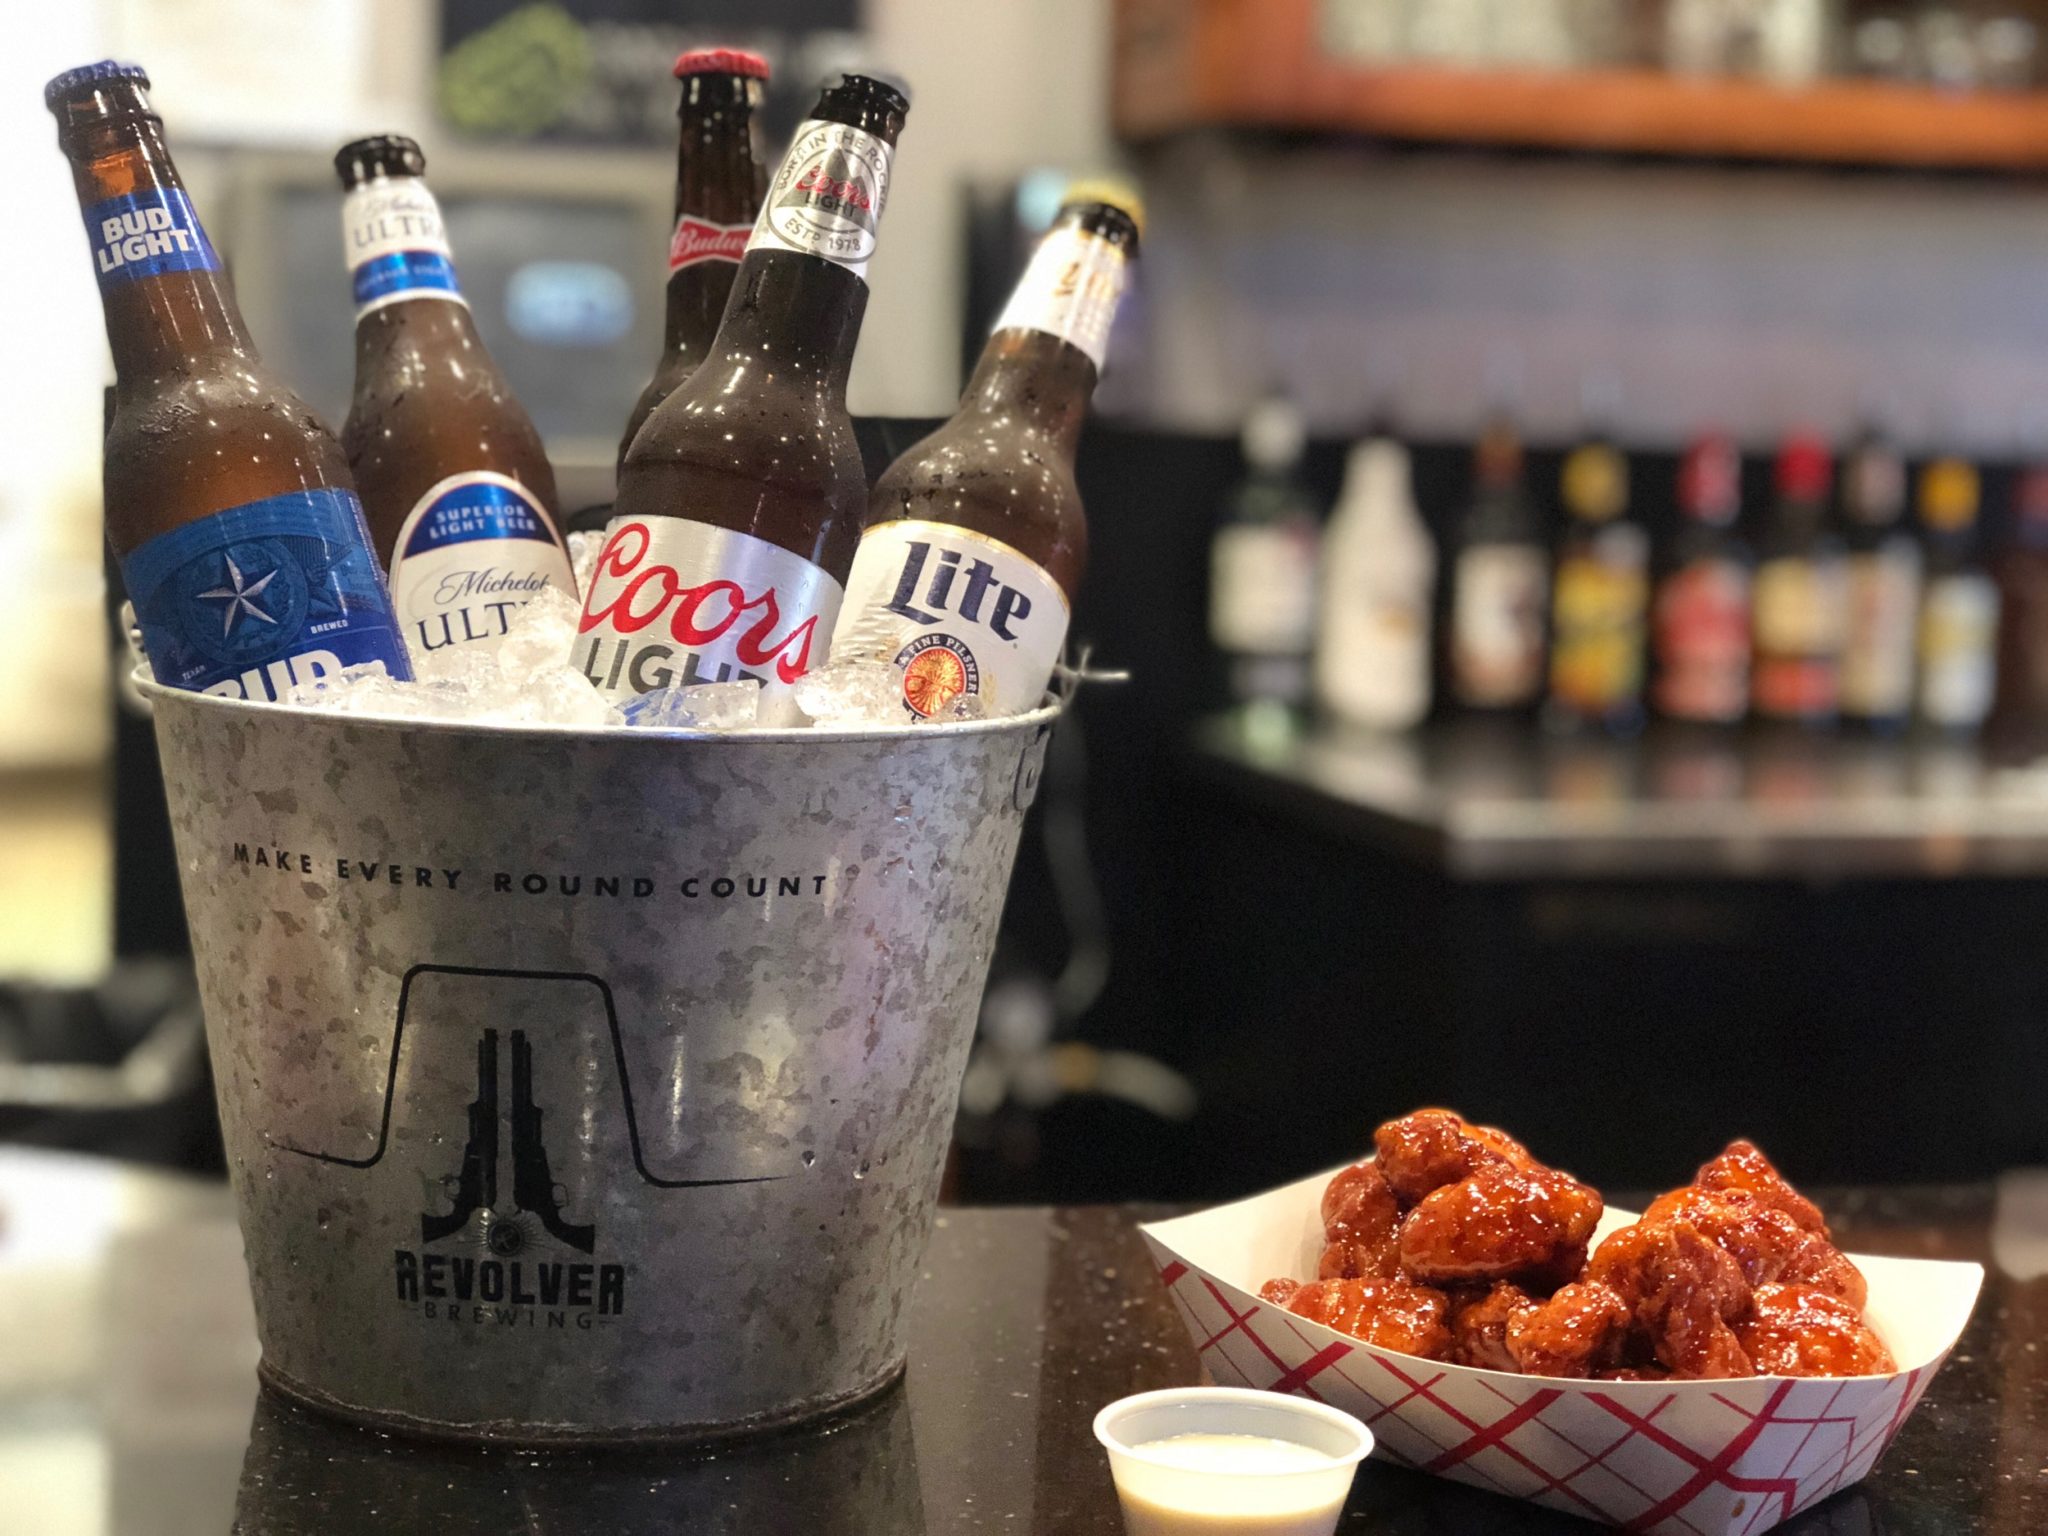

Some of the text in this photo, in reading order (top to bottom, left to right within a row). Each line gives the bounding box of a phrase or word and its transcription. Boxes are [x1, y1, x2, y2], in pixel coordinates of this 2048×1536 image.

[808, 133, 828, 150] IN
[795, 160, 871, 214] Coors
[804, 190, 857, 218] LIGHT
[101, 207, 172, 245] BUD
[828, 237, 862, 252] 1978
[98, 229, 191, 274] LIGHT
[429, 518, 536, 540] LIGHT BEER
[436, 504, 526, 524] SUPERIOR
[578, 522, 818, 685] Coors
[882, 541, 1032, 641] Lite
[310, 619, 349, 634] BREWED
[416, 600, 530, 652] ULT
[908, 634, 942, 656] FINE
[945, 634, 979, 694] PILSNER
[233, 842, 827, 898] MAKE EVERY ROUND COUNT
[394, 1249, 625, 1316] REVOLVER
[423, 1301, 593, 1330] BREWING
